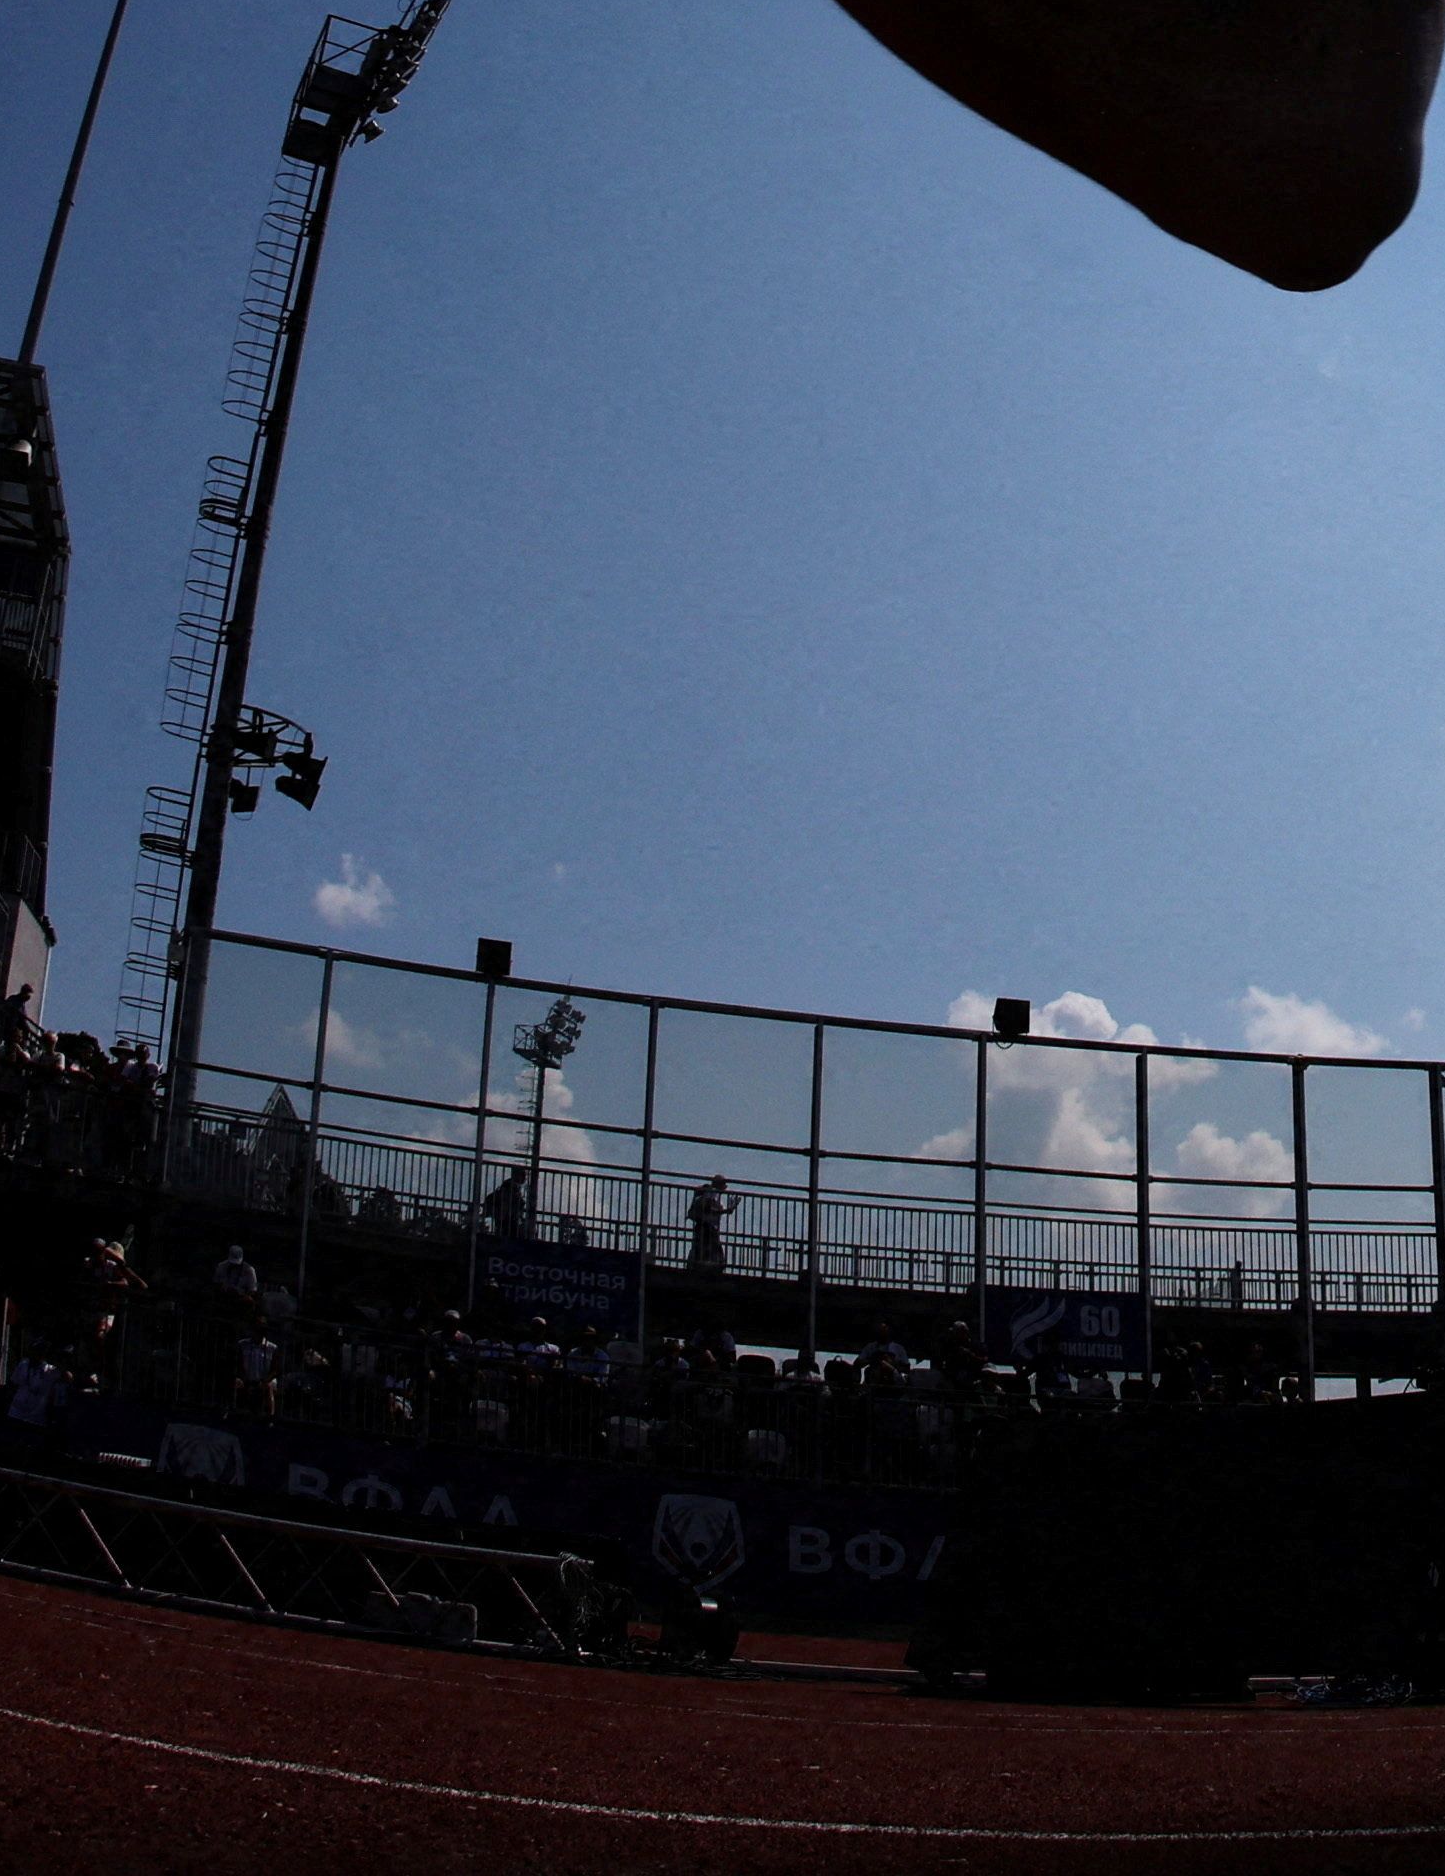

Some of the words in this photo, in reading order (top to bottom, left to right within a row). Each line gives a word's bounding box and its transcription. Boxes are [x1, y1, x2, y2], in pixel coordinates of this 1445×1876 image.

[487, 1255, 626, 1291] Восточная
[500, 1283, 610, 1310] трибуна
[1079, 1304, 1121, 1338] 60
[788, 1524, 947, 1581] ВФ
